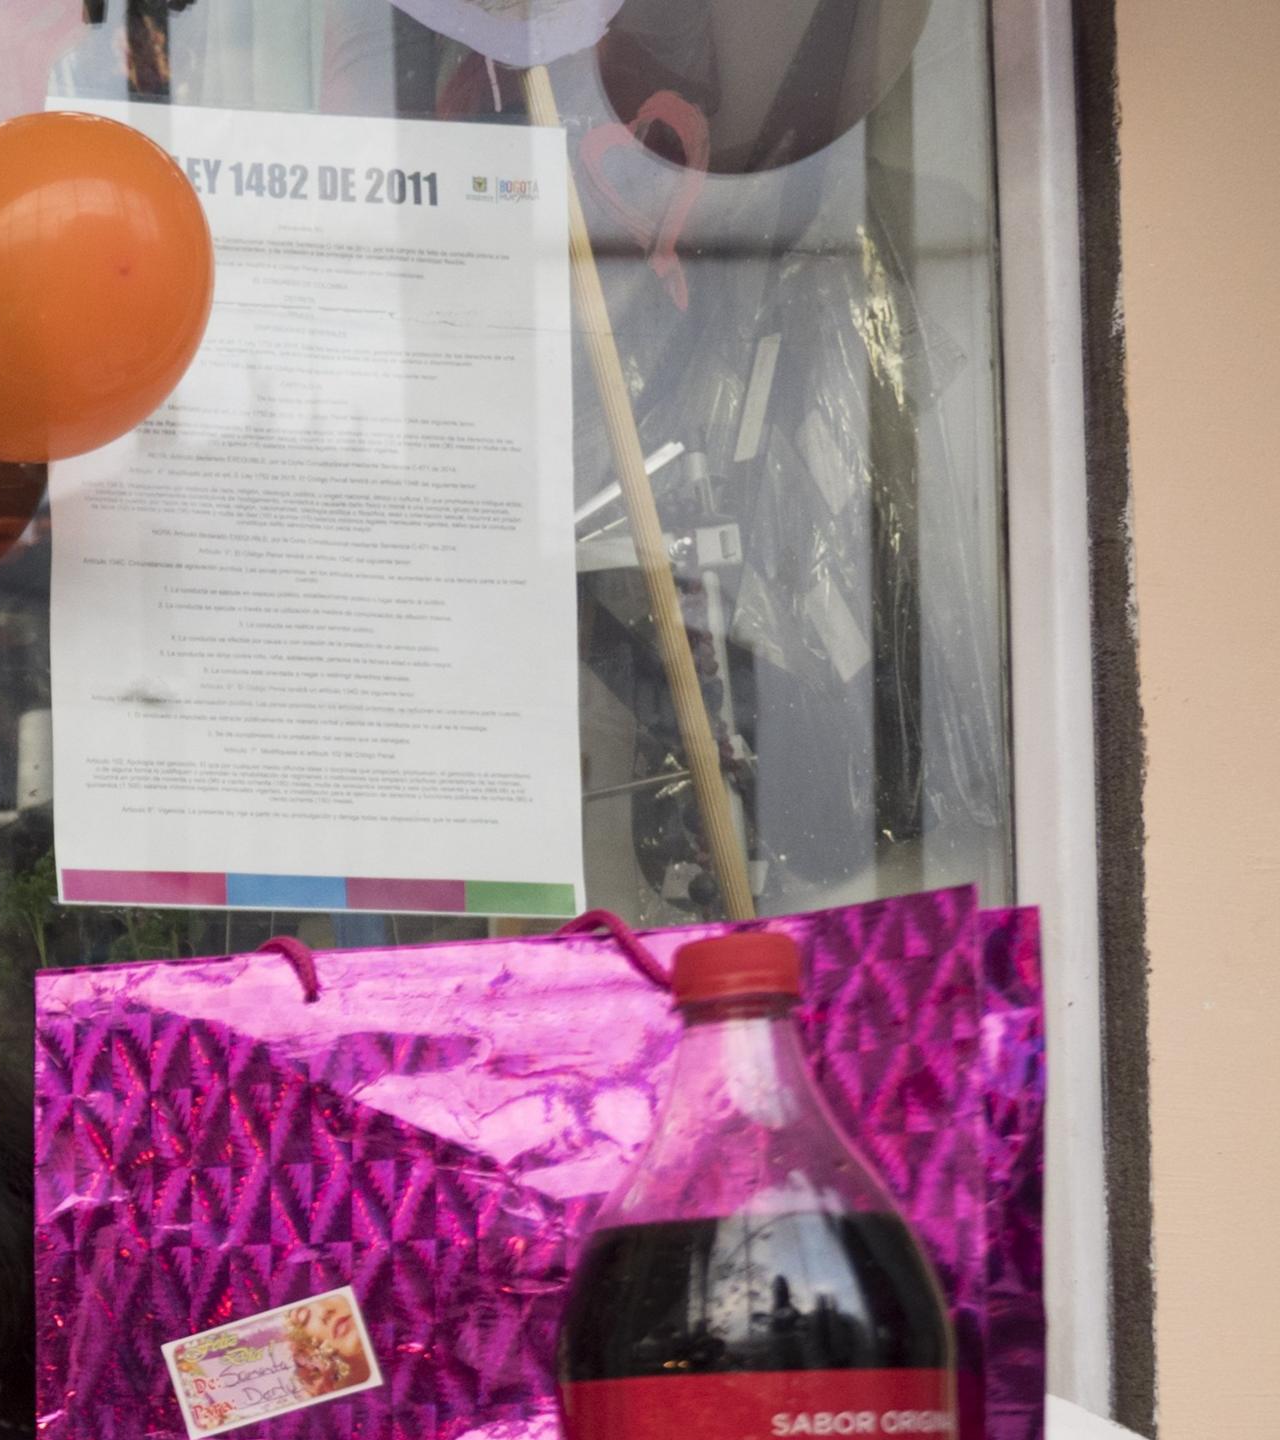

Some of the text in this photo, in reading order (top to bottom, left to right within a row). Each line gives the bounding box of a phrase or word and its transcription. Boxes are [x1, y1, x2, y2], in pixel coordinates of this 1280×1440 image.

[229, 162, 308, 200] 1482
[318, 165, 357, 203] DE
[364, 167, 438, 207] 2011
[771, 1411, 877, 1437] SABOR
